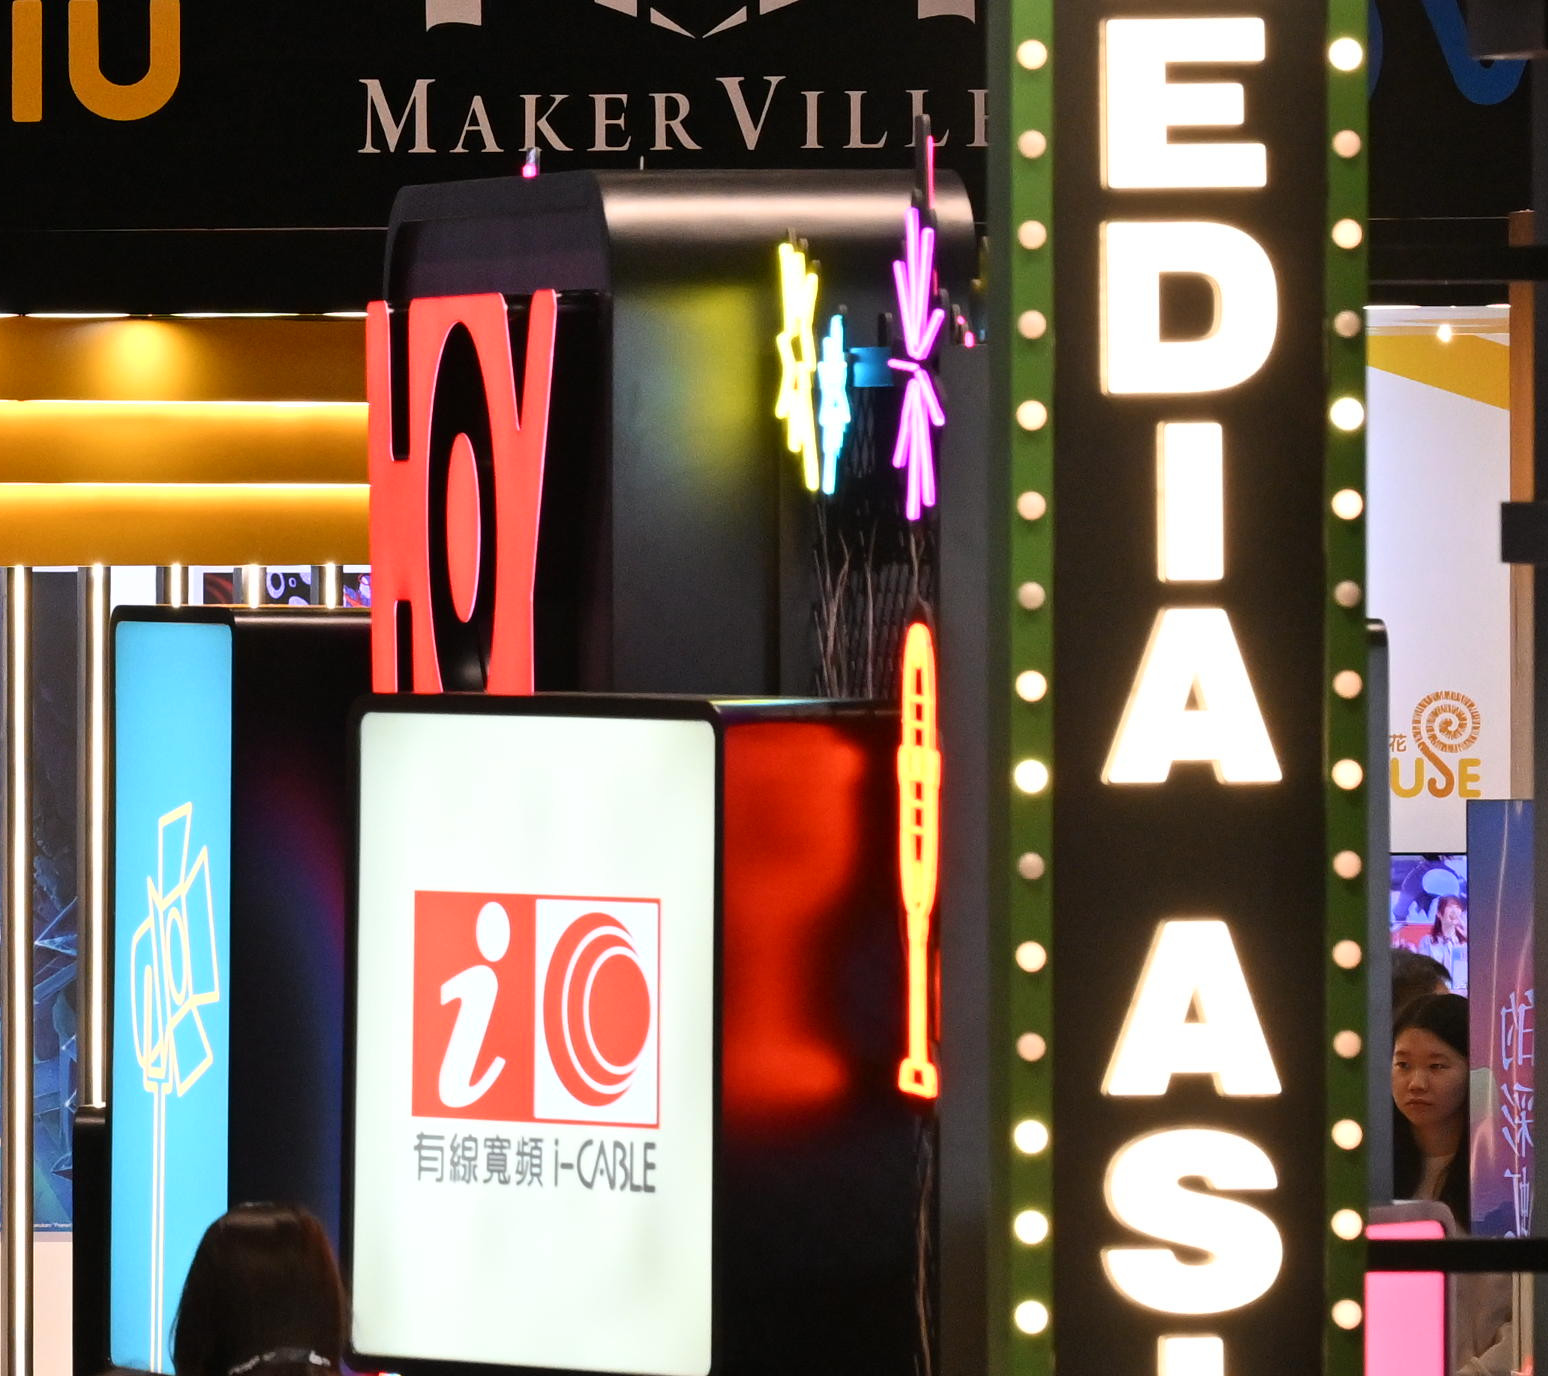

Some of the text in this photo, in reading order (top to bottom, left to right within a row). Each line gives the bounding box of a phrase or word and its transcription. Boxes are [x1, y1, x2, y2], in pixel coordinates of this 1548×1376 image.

[367, 288, 557, 693] HOY
[413, 1131, 544, 1188] 有線寬頻
[554, 1137, 656, 1194] i-CABLE
